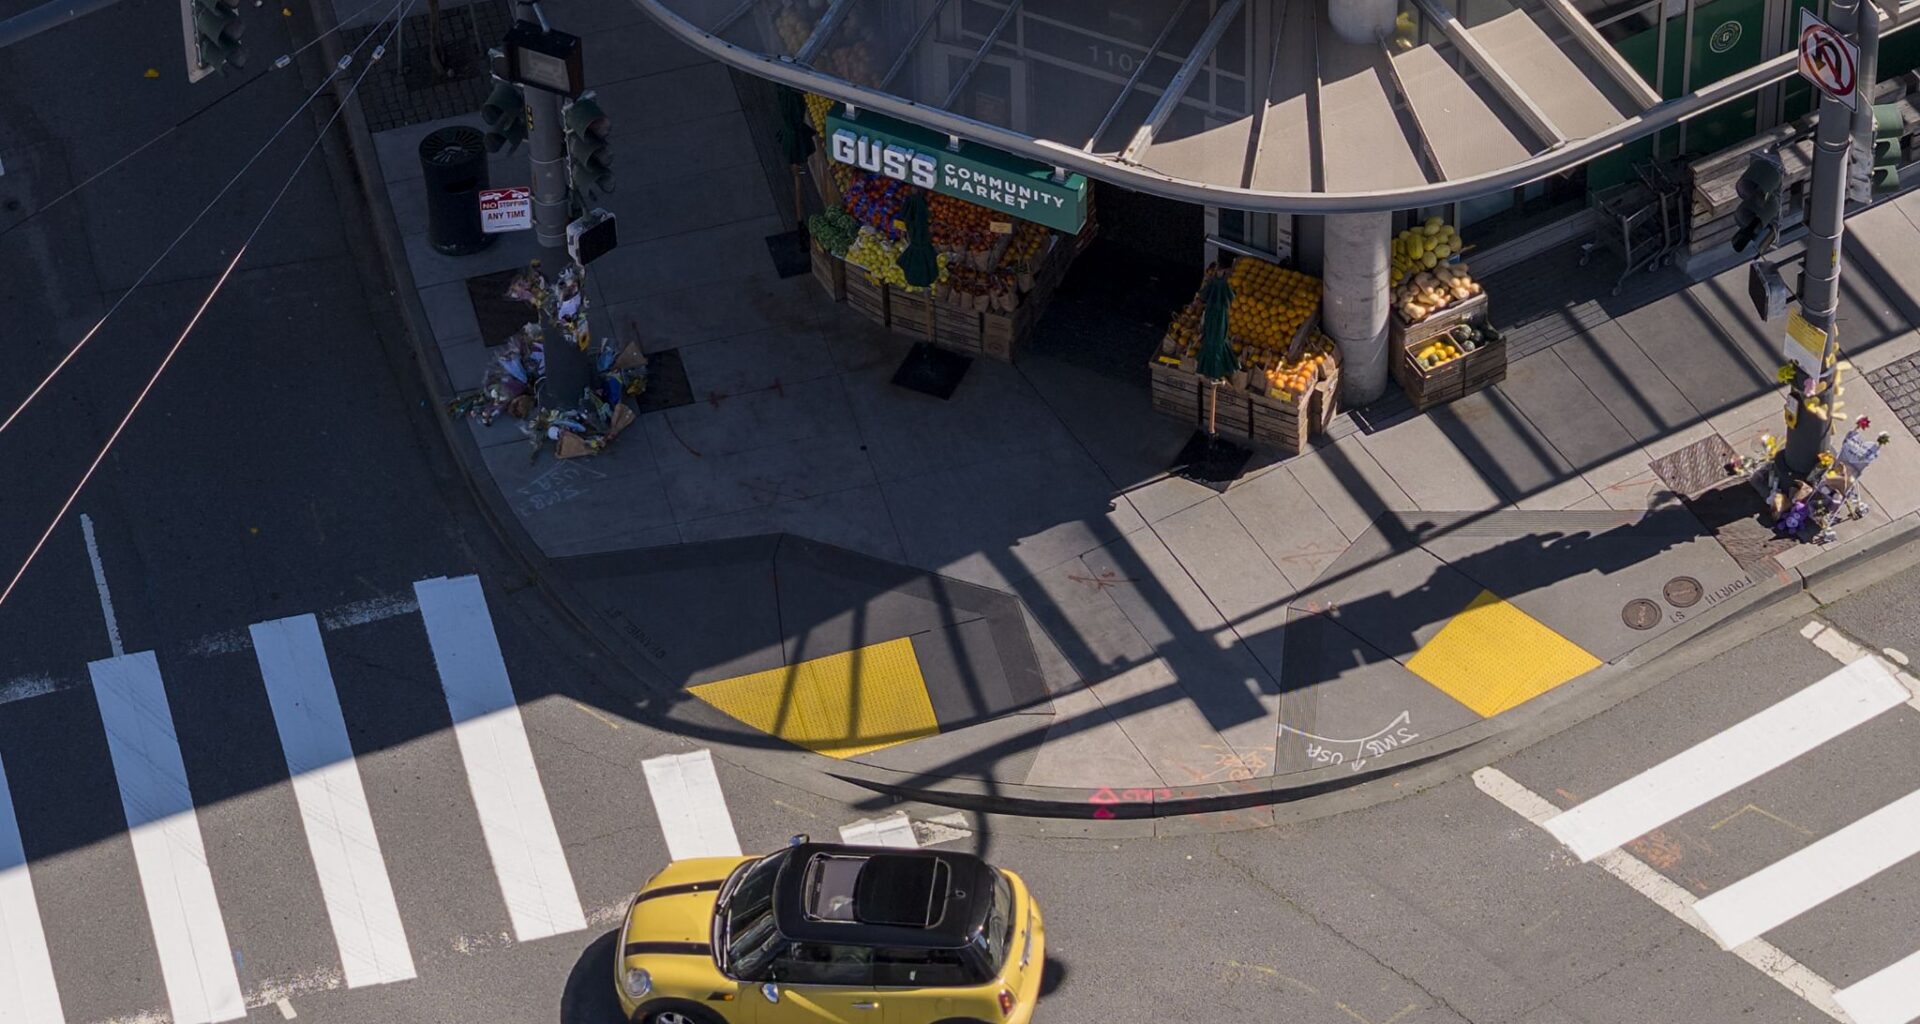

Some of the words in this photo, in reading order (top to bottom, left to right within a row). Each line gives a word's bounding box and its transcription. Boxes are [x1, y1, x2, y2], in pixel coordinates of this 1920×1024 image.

[1088, 44, 1142, 72] 110
[832, 128, 937, 190] GUS'S
[945, 163, 1065, 208] COMMUNITY
[945, 176, 1029, 210] MARKET
[488, 212, 504, 220] ANY
[506, 210, 526, 219] TIME
[1703, 575, 1752, 605] FOURTH
[1668, 611, 1685, 624] ST
[1305, 743, 1344, 765] USA
